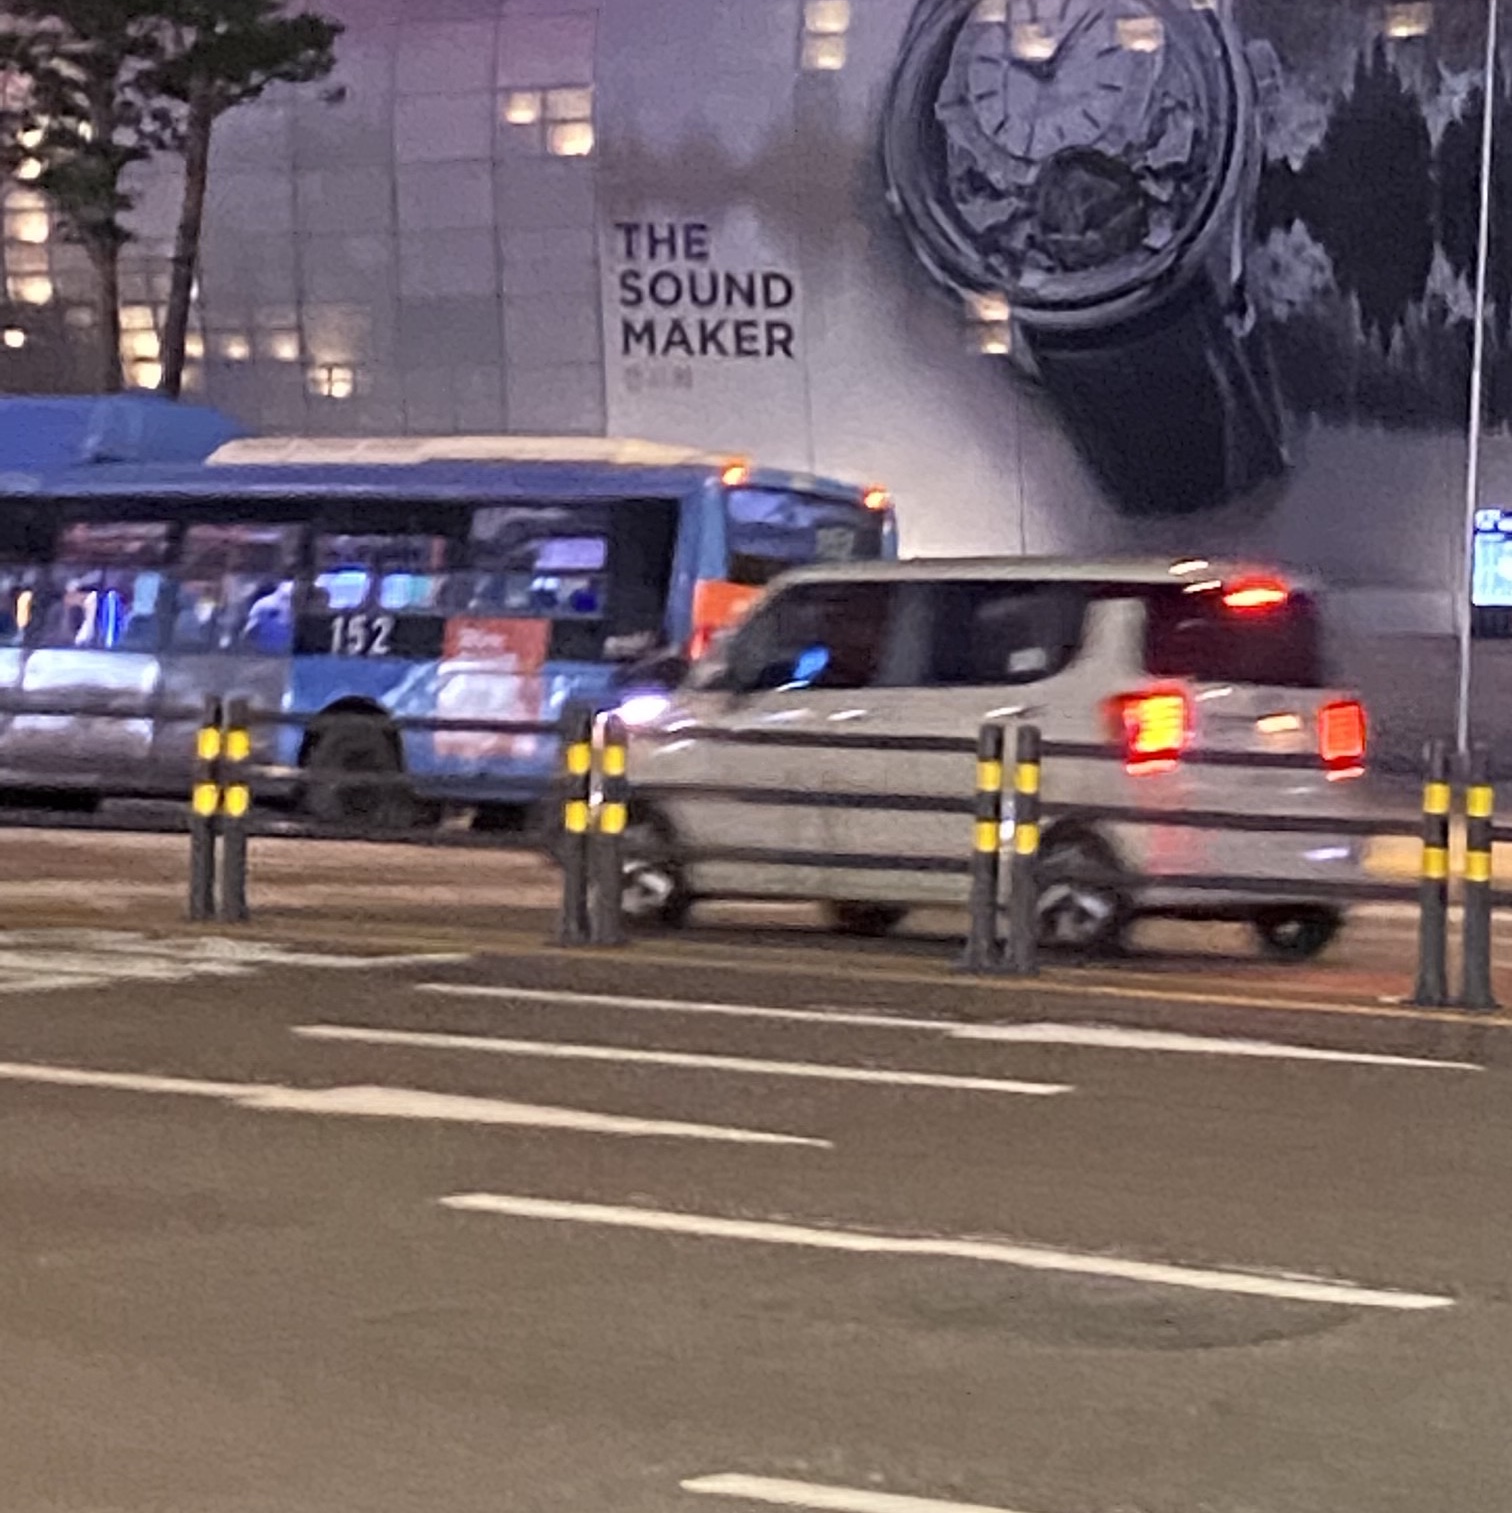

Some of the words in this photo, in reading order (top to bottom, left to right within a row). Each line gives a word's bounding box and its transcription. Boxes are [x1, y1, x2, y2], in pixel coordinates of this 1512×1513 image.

[614, 221, 710, 260] THE
[618, 268, 795, 309] SOUND
[620, 317, 797, 359] MAKER
[330, 614, 396, 656] 152
